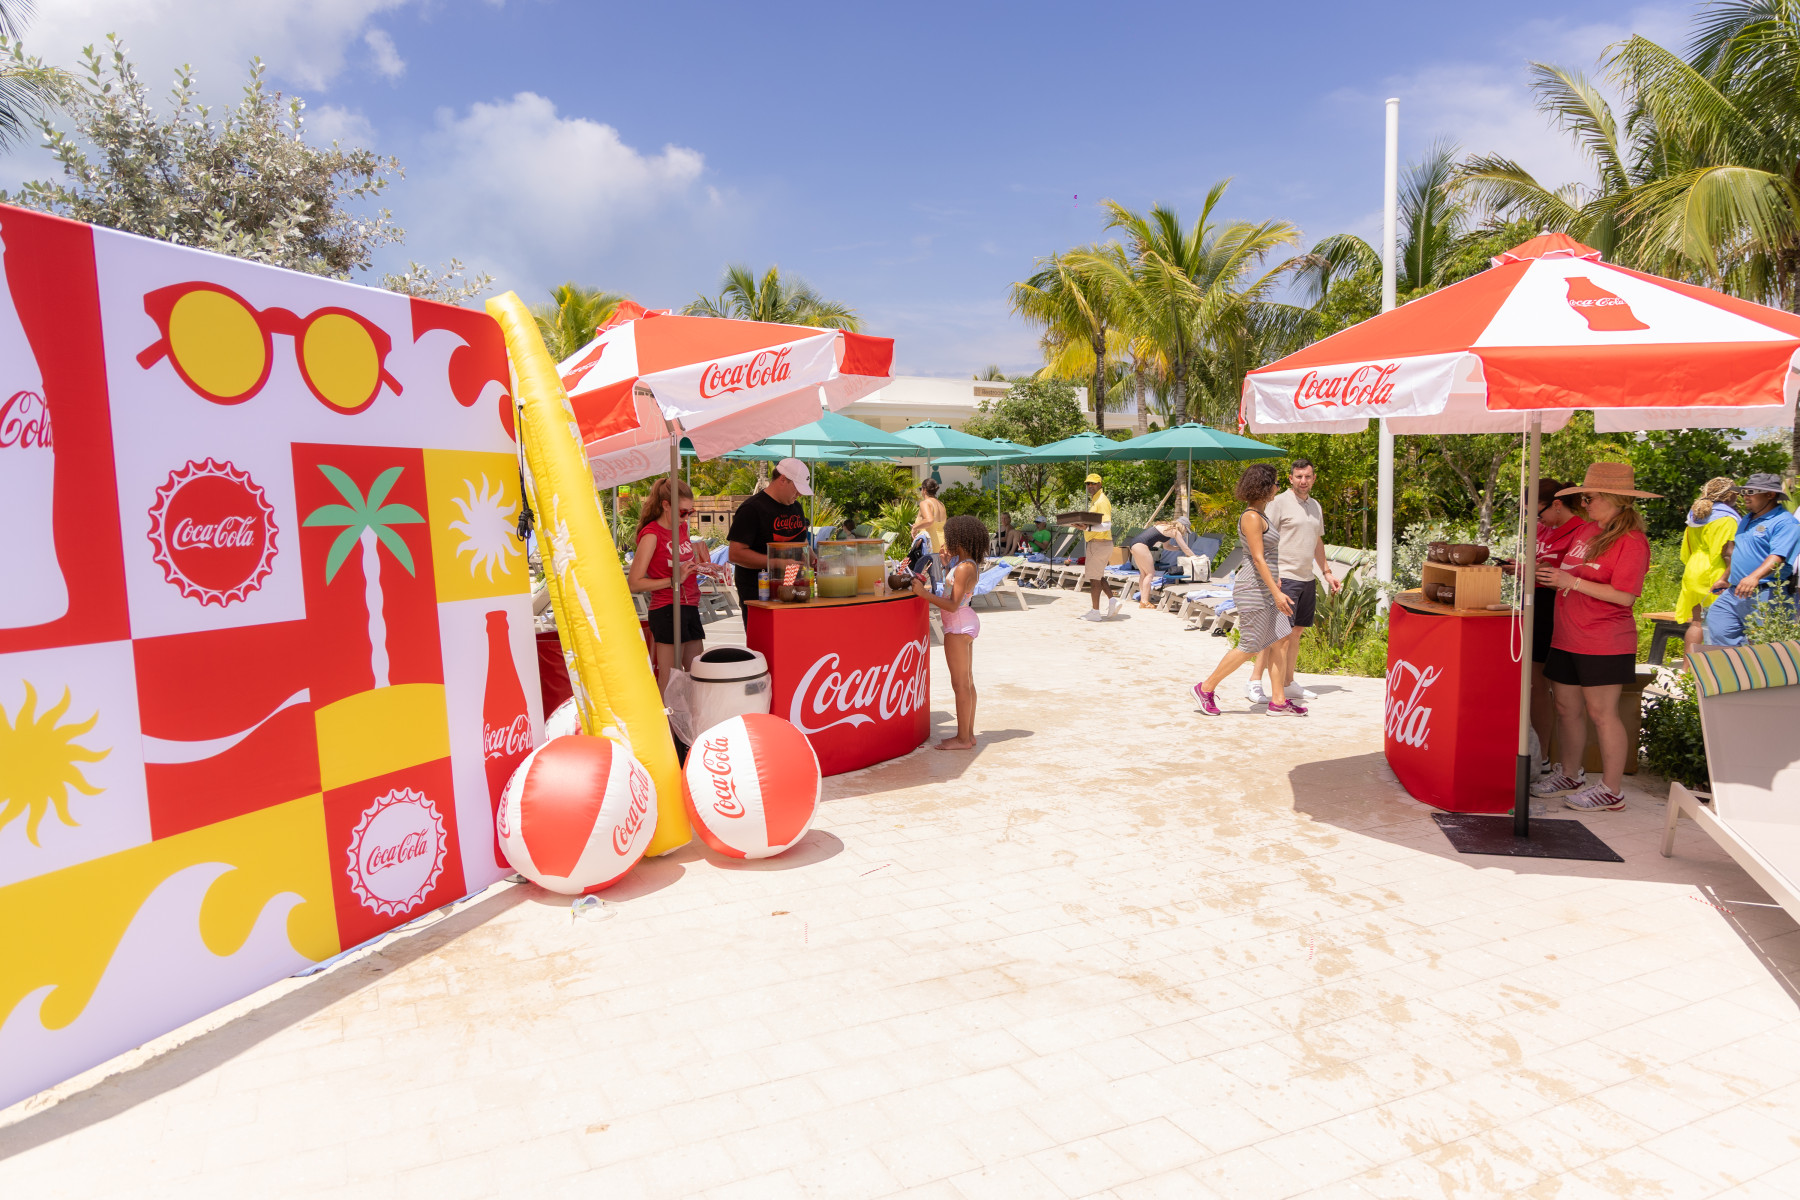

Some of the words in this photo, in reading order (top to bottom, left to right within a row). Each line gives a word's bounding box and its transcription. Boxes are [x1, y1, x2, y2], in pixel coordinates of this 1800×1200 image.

[1569, 297, 1627, 307] oca-Cola
[699, 347, 792, 399] Coca-Cola
[1294, 363, 1402, 410] Coca-Cola
[172, 516, 257, 551] Coca-Cola
[789, 633, 929, 735] Coca-Cola
[702, 736, 746, 819] Coca-Cola
[612, 759, 649, 857] Coca-Cola
[366, 827, 430, 876] Coca-Cola
